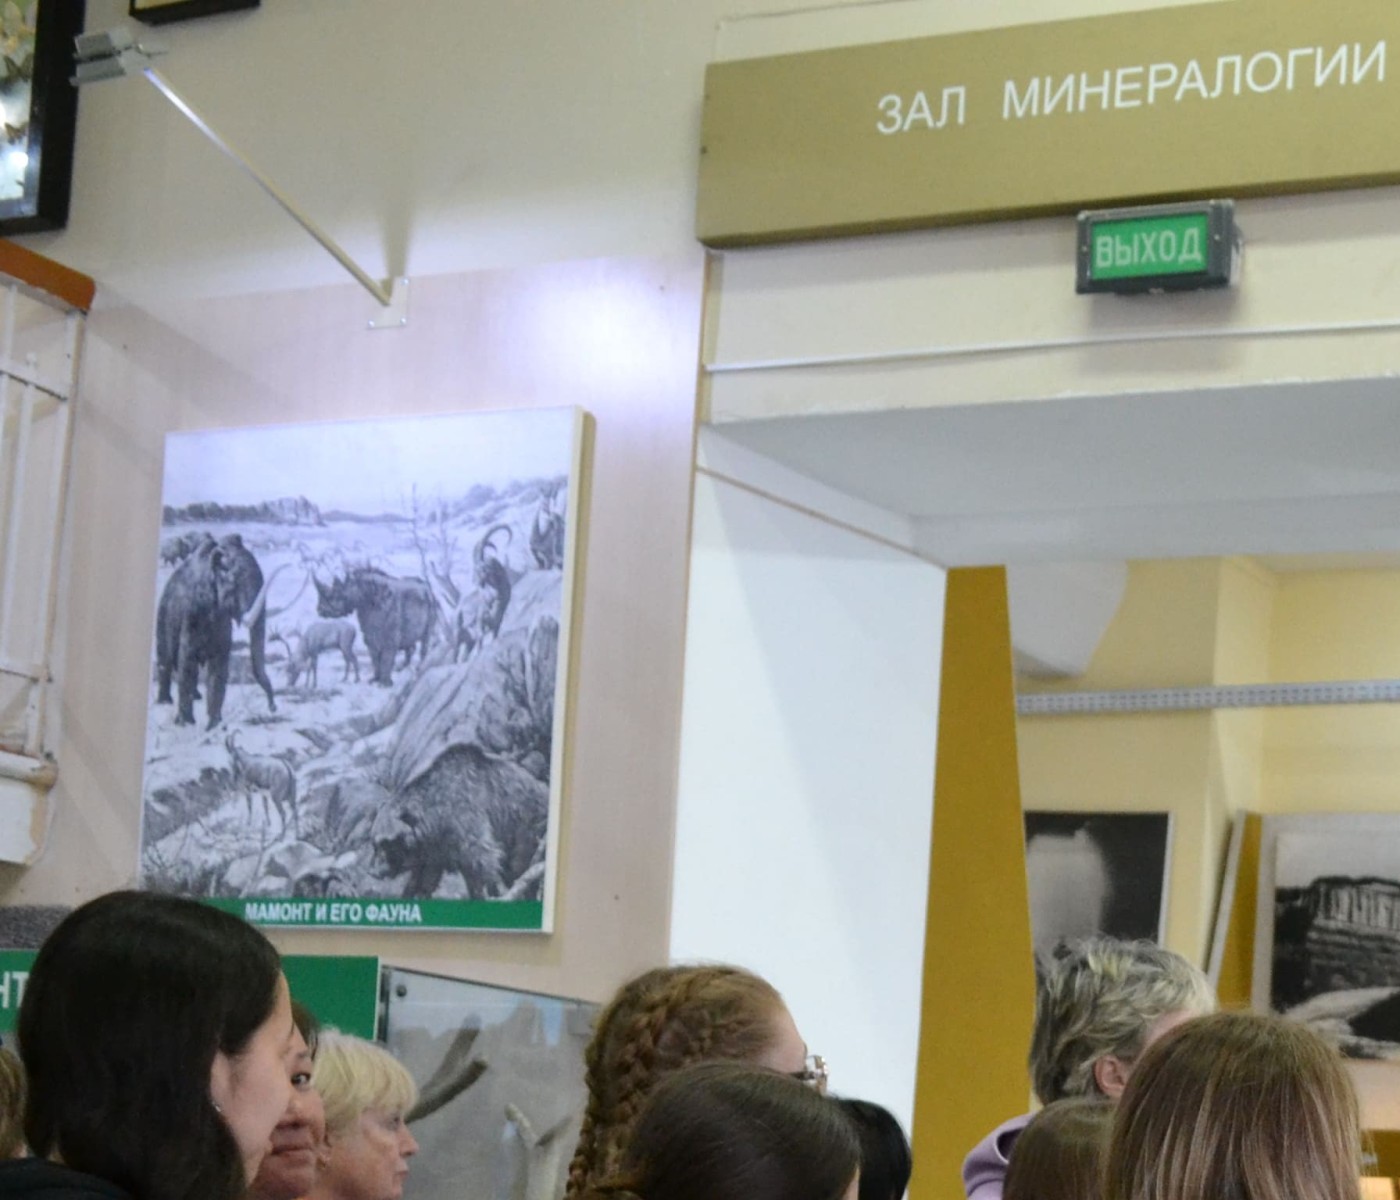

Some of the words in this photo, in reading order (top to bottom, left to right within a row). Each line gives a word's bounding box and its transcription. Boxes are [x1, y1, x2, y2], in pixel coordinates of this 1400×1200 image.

[875, 86, 966, 136] ЗАЛ
[1002, 40, 1388, 121] МИНЕРАЛОГИИ
[1096, 227, 1202, 269] ВЫХОД
[244, 902, 313, 922] МАМОНТ
[315, 903, 327, 922] И
[329, 903, 364, 923] ЕГО
[365, 904, 422, 923] ФАУНА
